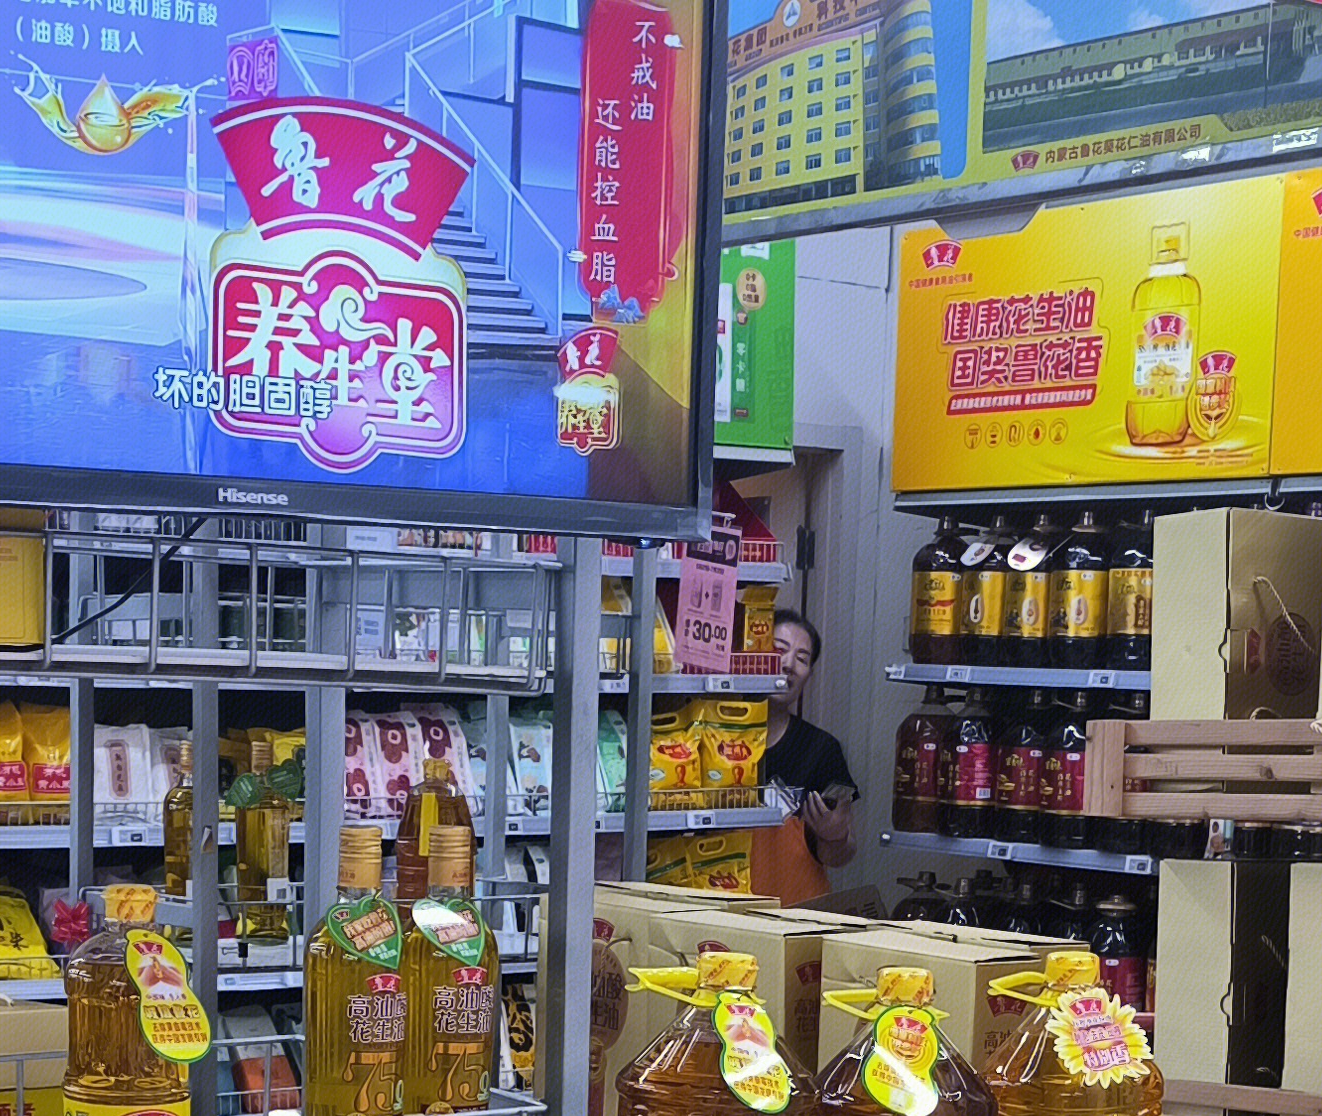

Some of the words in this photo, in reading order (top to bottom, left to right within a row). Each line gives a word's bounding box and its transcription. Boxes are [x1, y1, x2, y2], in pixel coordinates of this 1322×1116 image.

[629, 20, 658, 124] 不戒油
[259, 114, 421, 216] 鲁花
[590, 96, 623, 285] 还能控血脂
[942, 287, 1097, 346] 健康花生油
[153, 363, 333, 420] 坏的胆固醇
[226, 283, 451, 432] 养生堂
[946, 332, 1105, 391] 国奖鲁花香
[216, 485, 289, 506] Hisense
